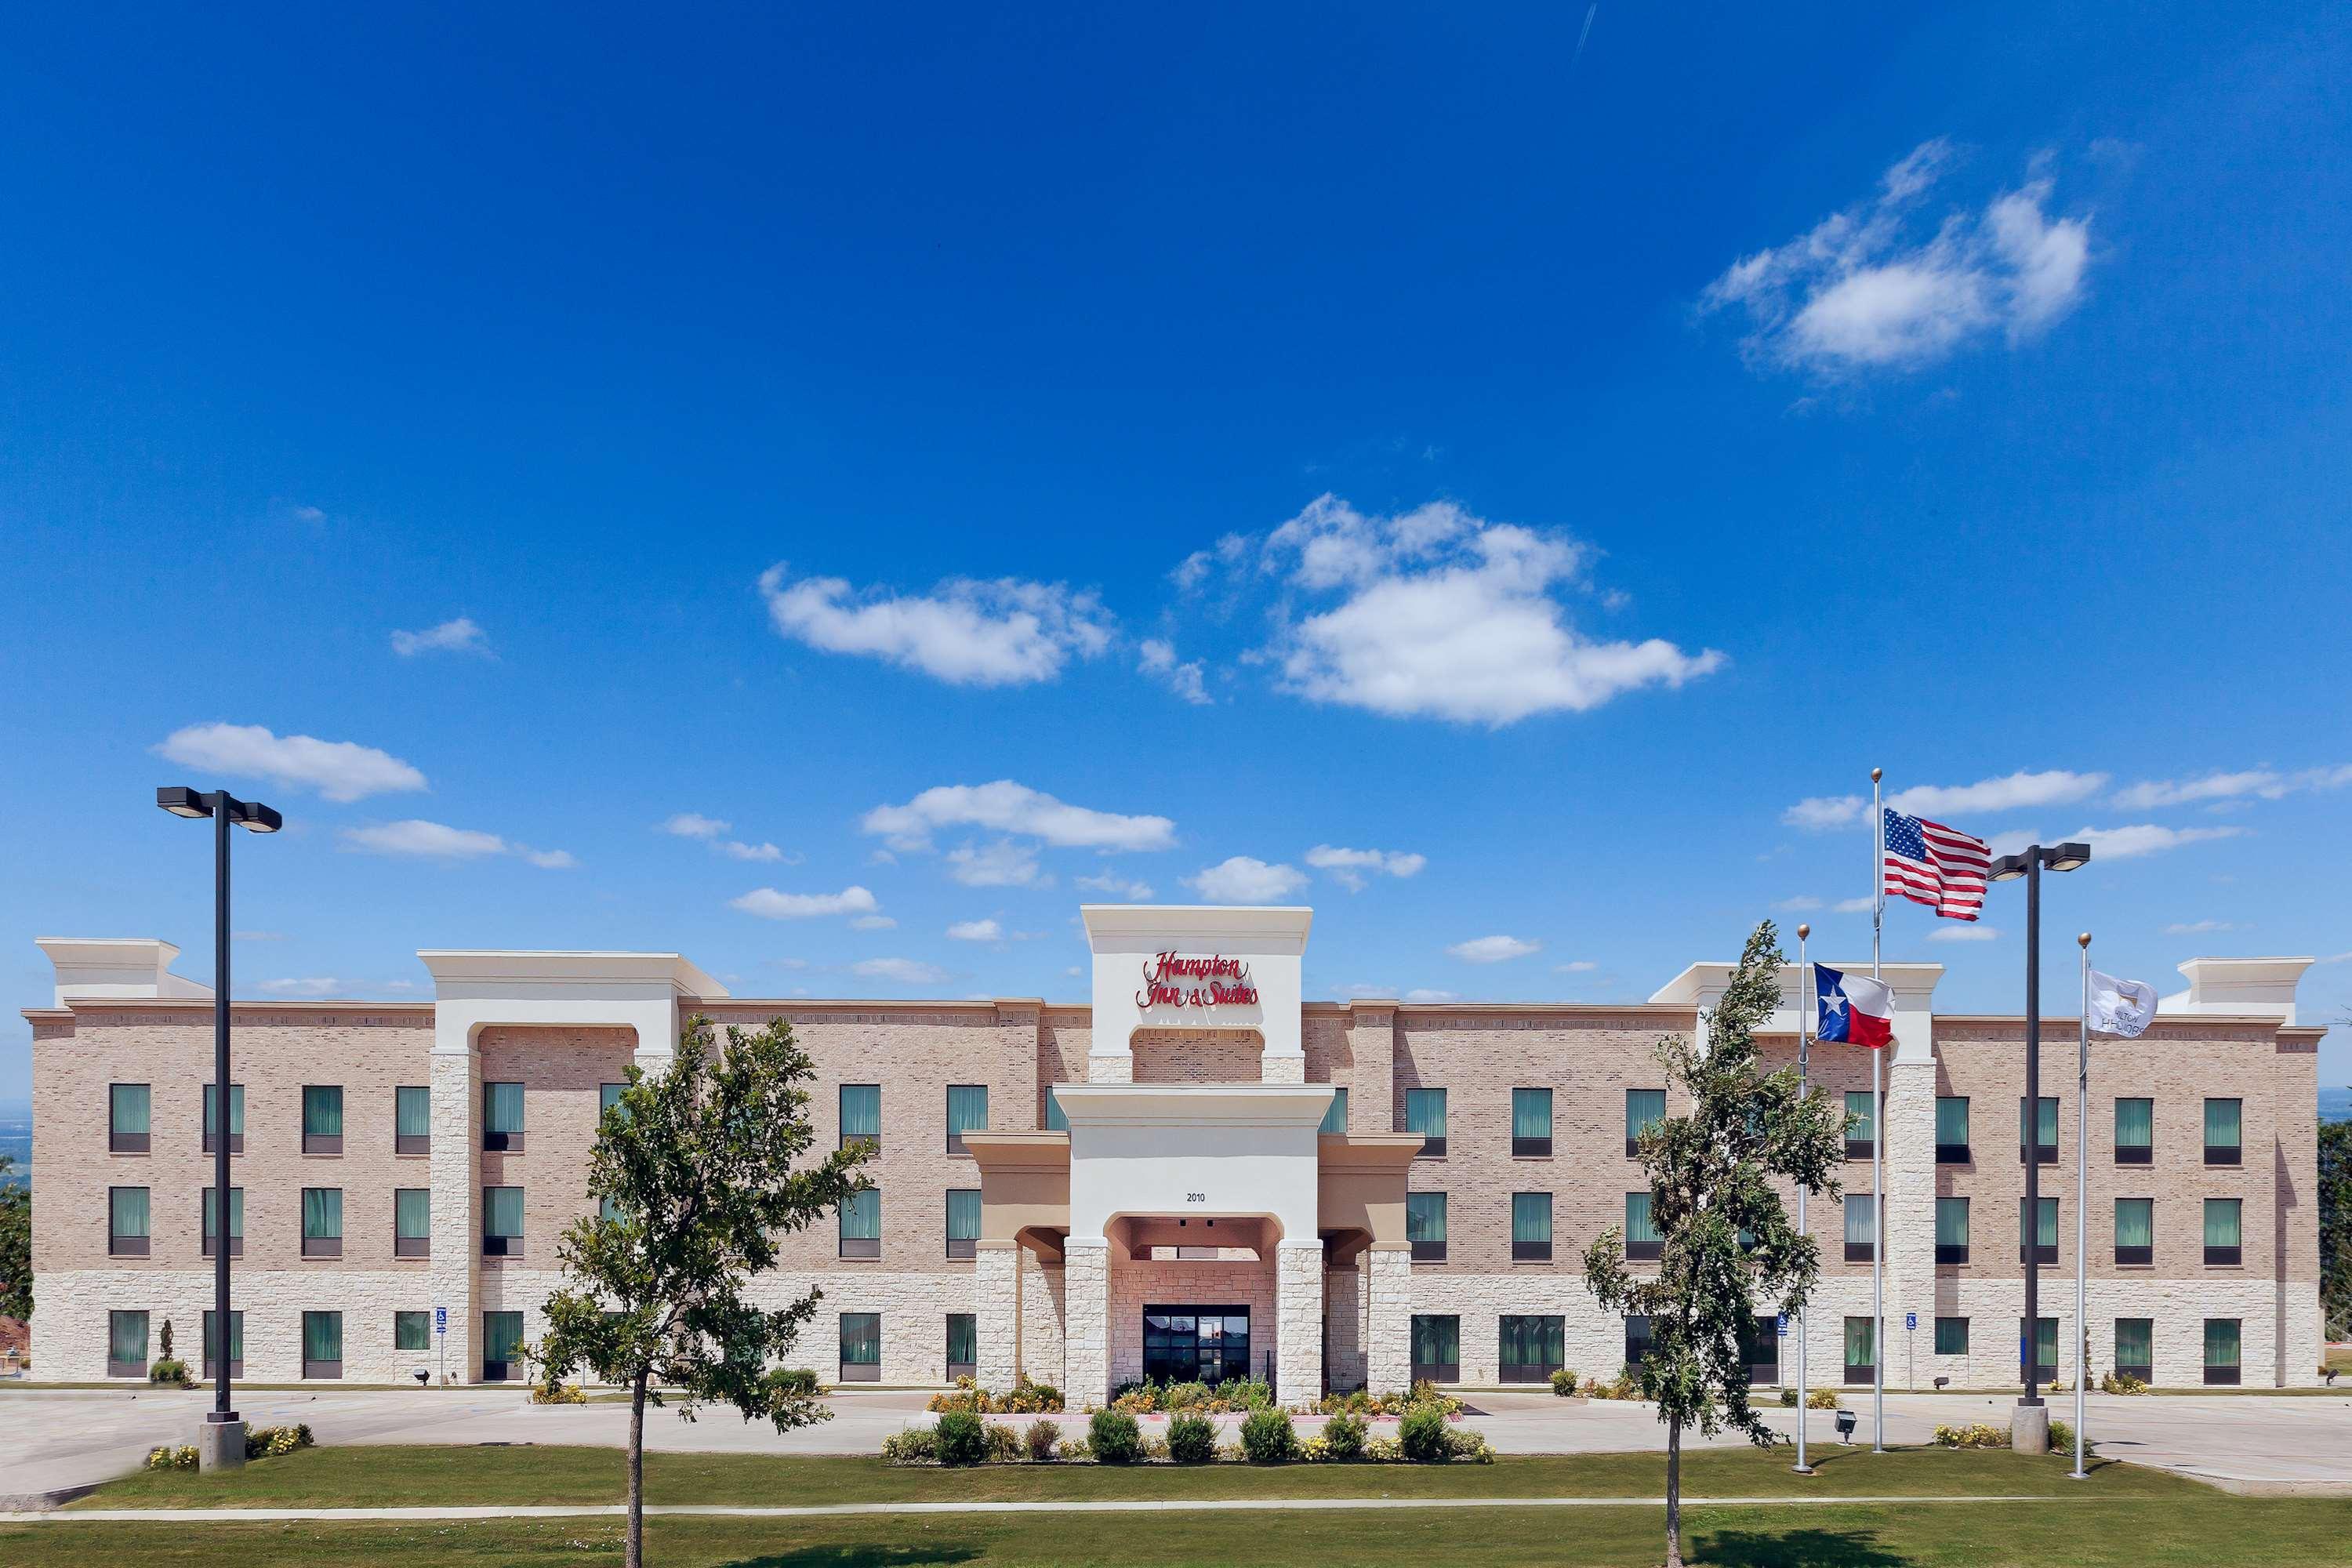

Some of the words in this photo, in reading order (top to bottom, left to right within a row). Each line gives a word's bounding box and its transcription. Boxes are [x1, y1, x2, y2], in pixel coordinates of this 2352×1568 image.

[1143, 950, 1249, 982] Hampton
[1136, 981, 1189, 1007] Inn
[1189, 988, 1203, 1007] &
[1202, 981, 1258, 1007] Suites
[1186, 1192, 1205, 1202] 2010
